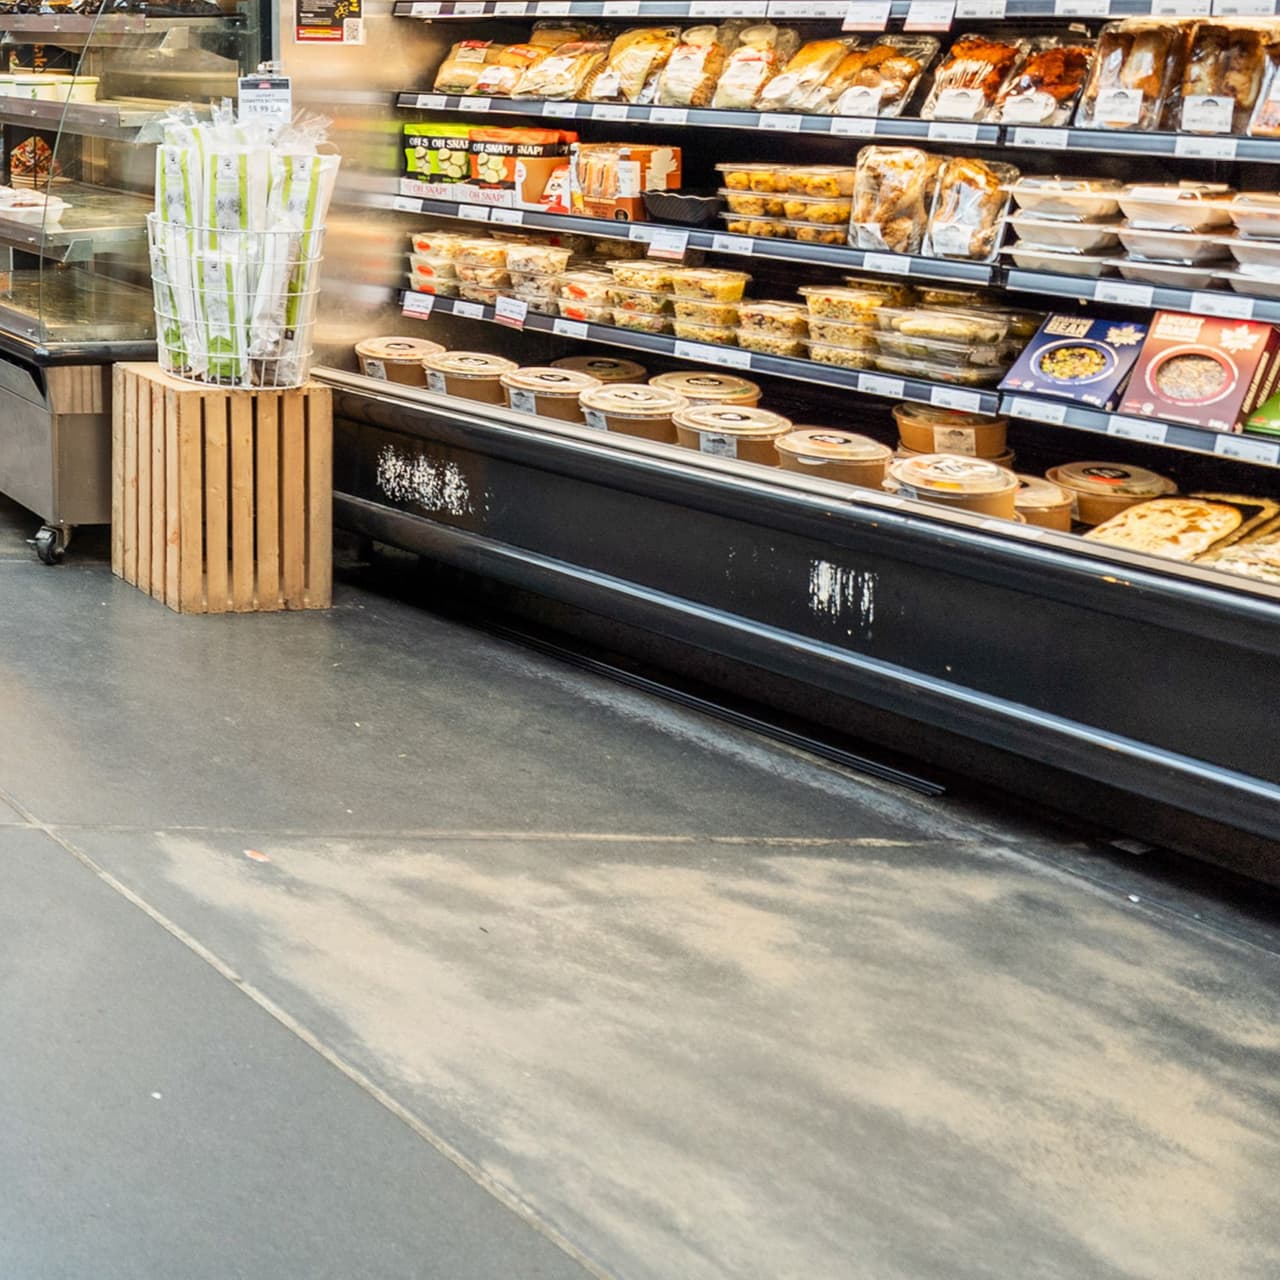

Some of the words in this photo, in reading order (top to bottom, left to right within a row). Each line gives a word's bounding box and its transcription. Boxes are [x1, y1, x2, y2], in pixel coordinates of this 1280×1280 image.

[432, 138, 445, 148] OH
[473, 142, 484, 152] OH
[484, 143, 514, 154] SNAP!
